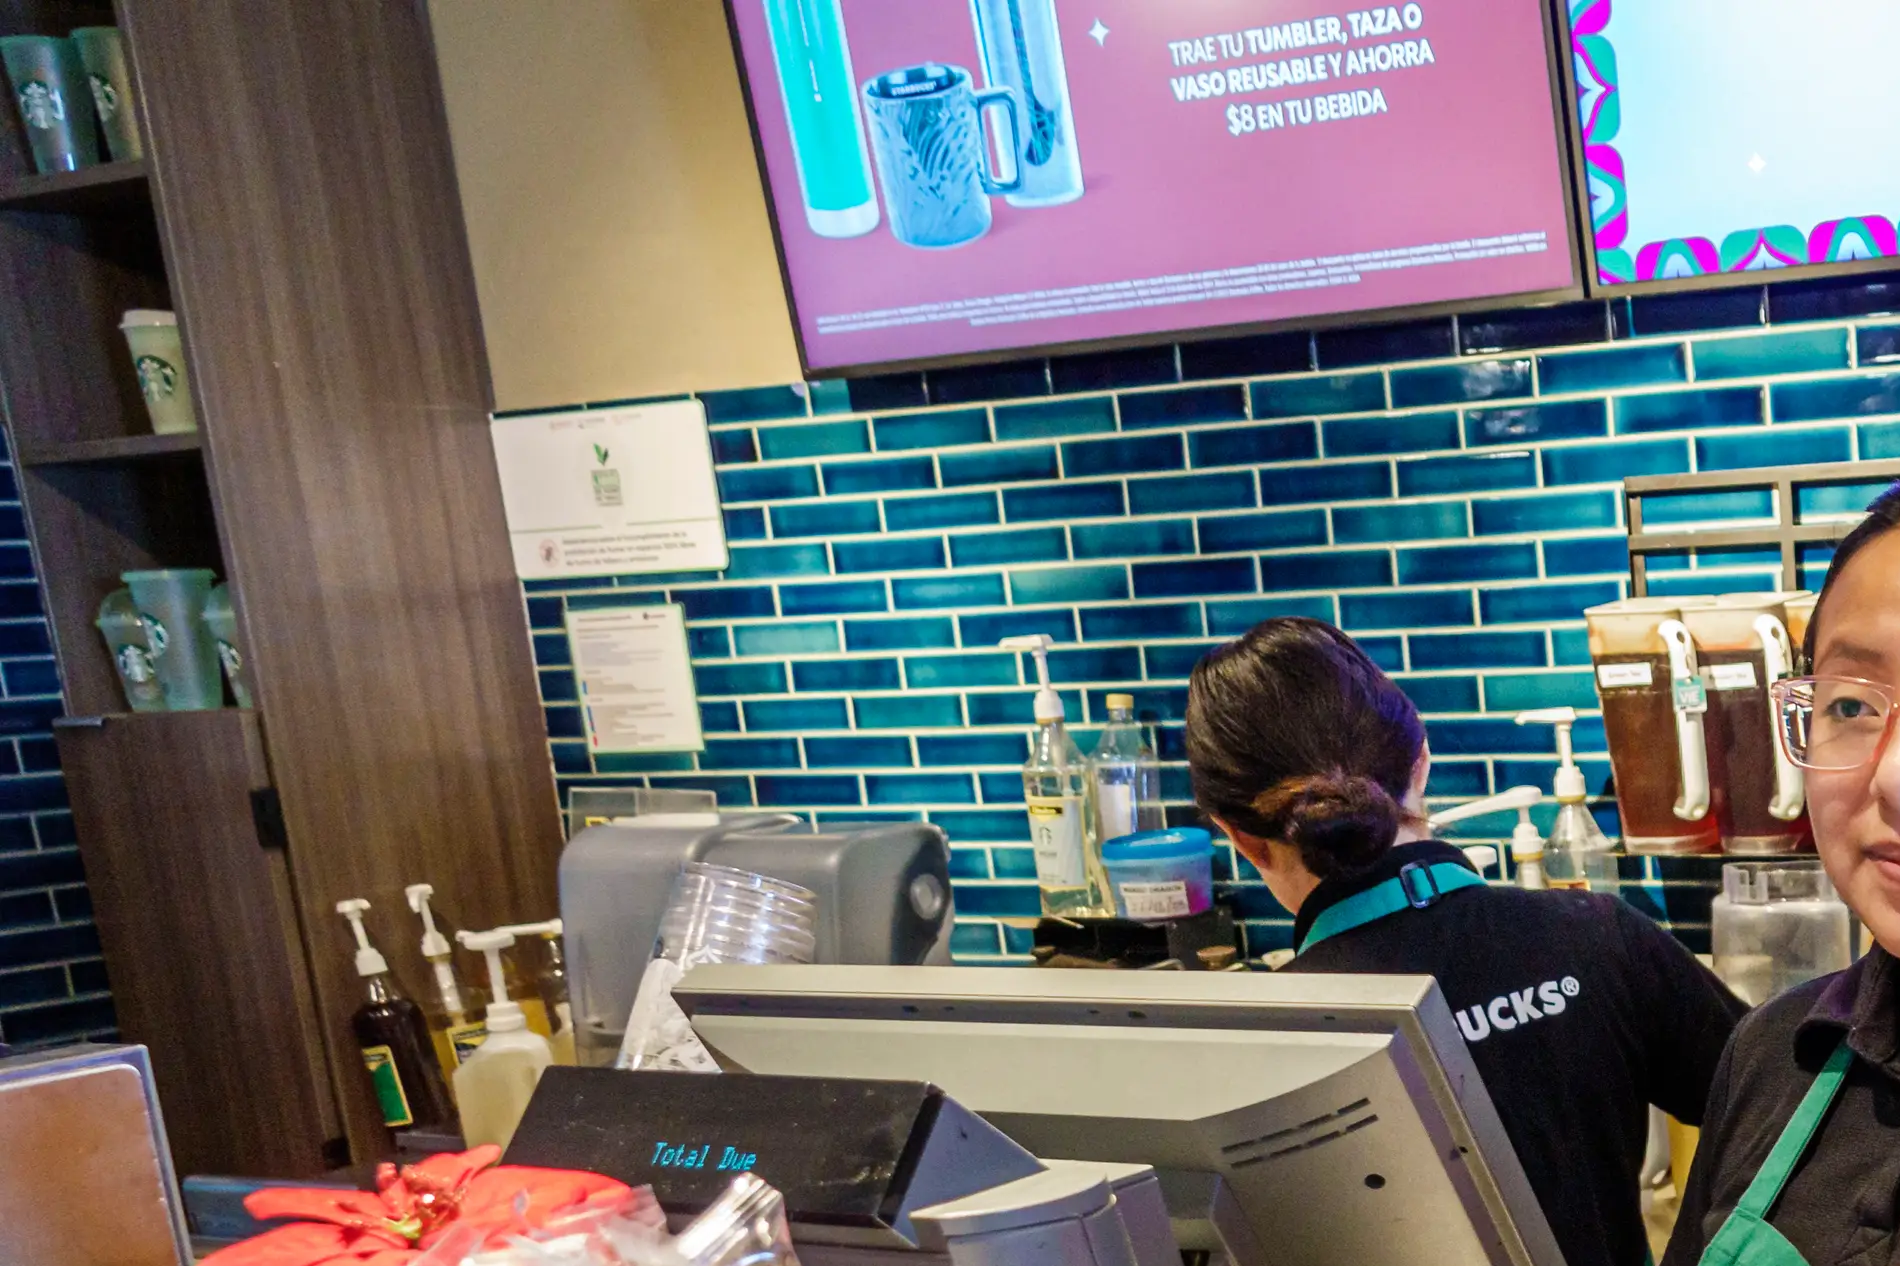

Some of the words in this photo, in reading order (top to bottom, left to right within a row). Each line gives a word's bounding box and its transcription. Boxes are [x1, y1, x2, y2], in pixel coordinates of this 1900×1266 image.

[1168, 36, 1217, 66] TRAE
[1216, 32, 1244, 59] TU
[1244, 16, 1348, 55] TUMBLER,
[1346, 6, 1402, 38] TAZA
[1402, 2, 1422, 29] O
[1170, 71, 1226, 101] VASO
[1227, 54, 1328, 94] REUSABLE
[1328, 52, 1342, 78] Y
[1346, 38, 1434, 76] AHORRA
[1226, 102, 1256, 136] $8
[1257, 102, 1284, 131] EN
[1285, 98, 1312, 126] TU
[1314, 88, 1388, 122] BEBIDA
[652, 1141, 710, 1168] Total
[717, 1146, 757, 1170] Due
